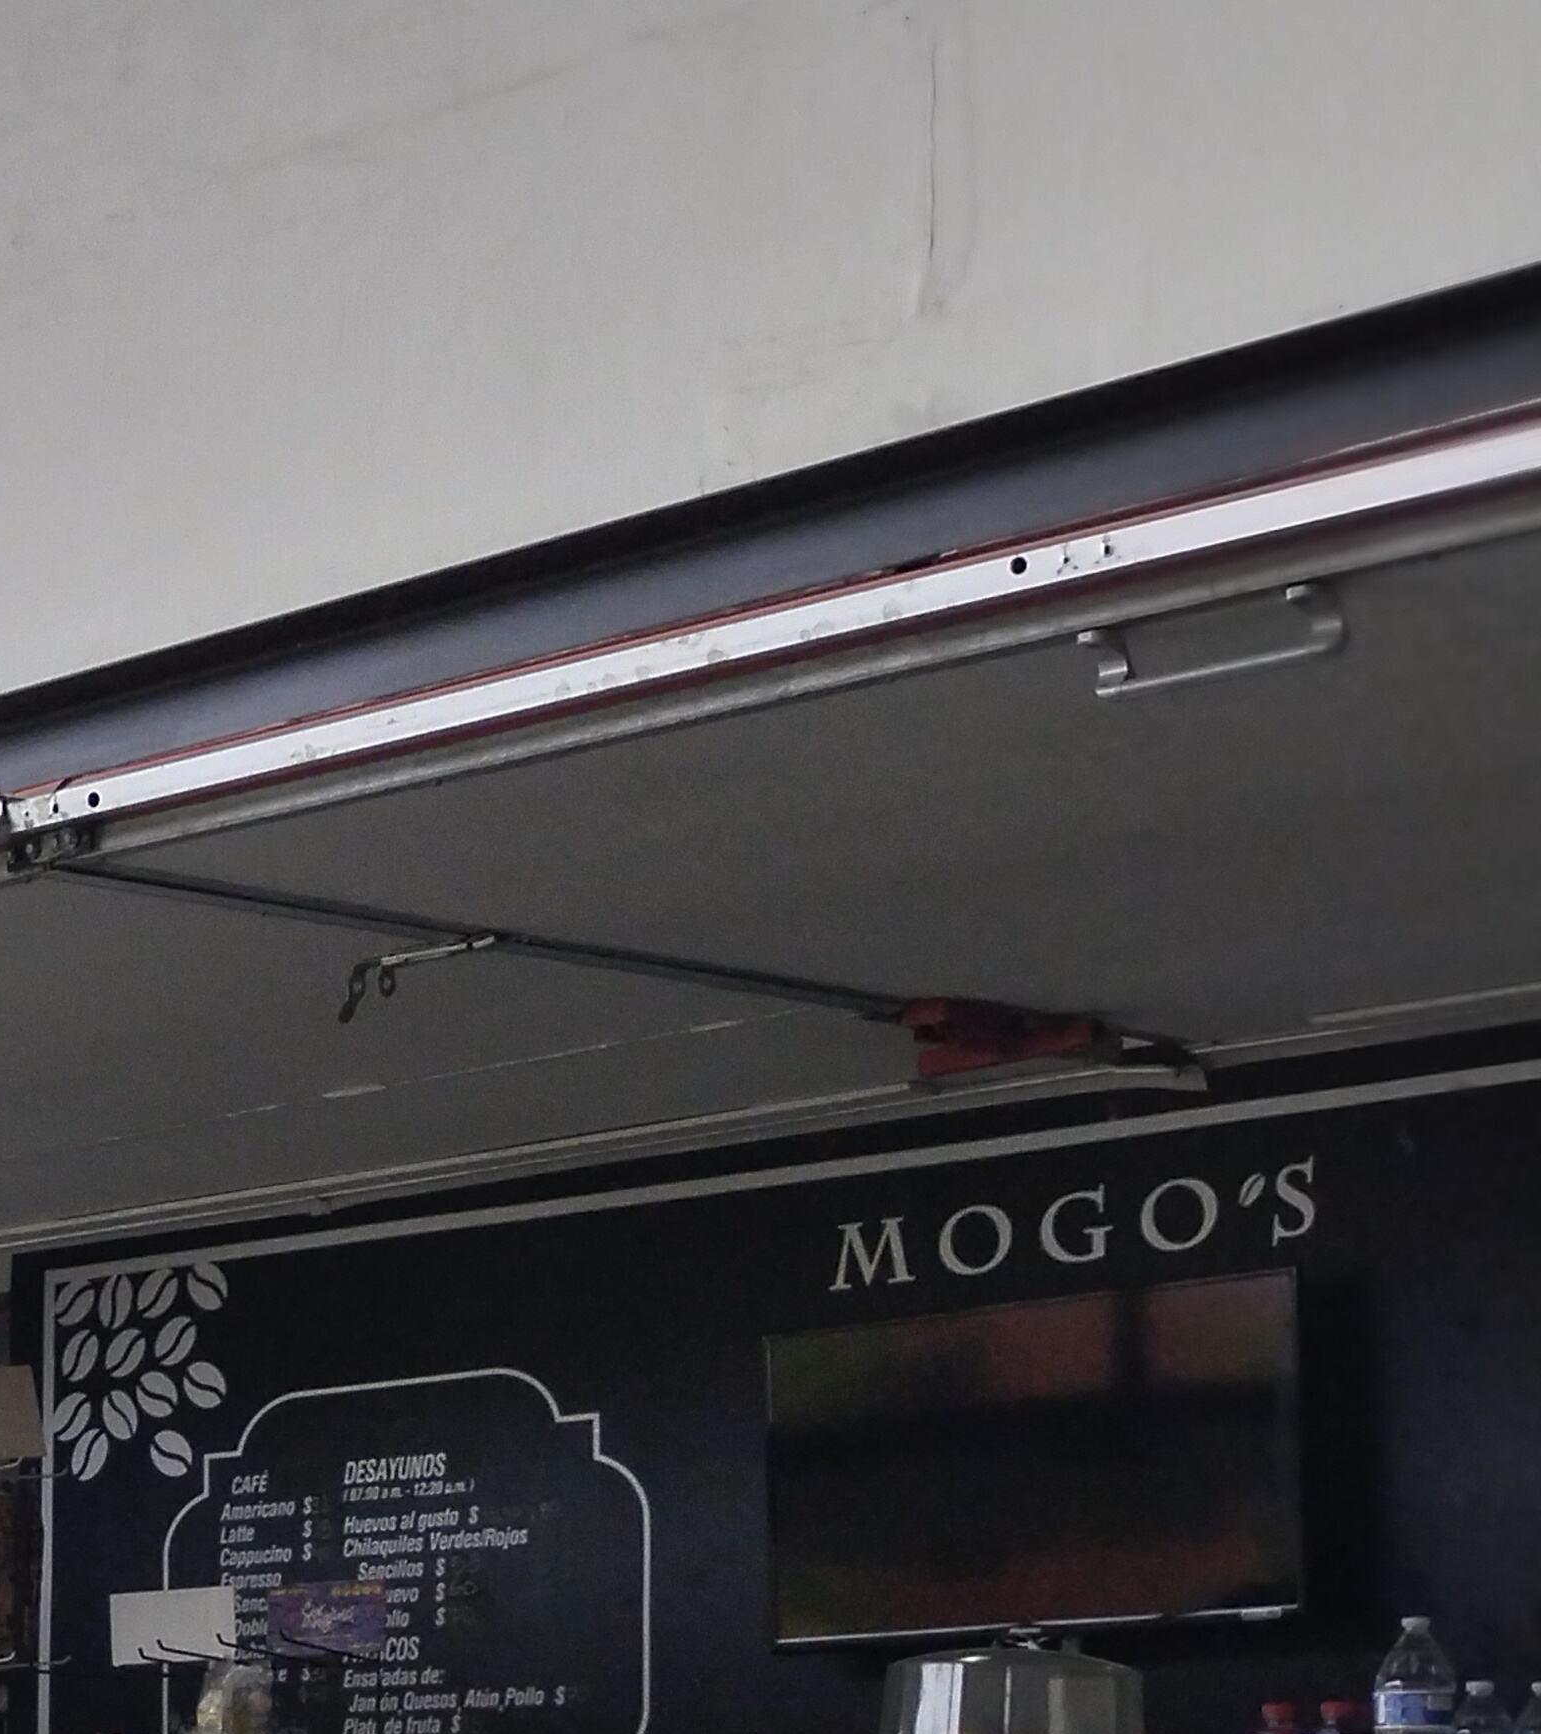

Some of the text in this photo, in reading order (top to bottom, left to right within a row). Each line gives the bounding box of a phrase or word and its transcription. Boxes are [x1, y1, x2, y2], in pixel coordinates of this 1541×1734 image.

[828, 1154, 1317, 1292] MOGO'S
[344, 1453, 447, 1485] DESAYUNOS
[232, 1470, 269, 1495] CAFÉ
[220, 1501, 295, 1522] Americano
[344, 1516, 398, 1535] Huevos
[400, 1511, 416, 1530] al
[418, 1509, 459, 1533] gusto
[221, 1525, 255, 1544] Latte
[344, 1527, 529, 1559] Chilaquiles Verdes/Rojos
[221, 1545, 292, 1569] Cappucino
[358, 1560, 424, 1581] Sencillos
[384, 1718, 402, 1734] de
[406, 1716, 442, 1734] fruta
